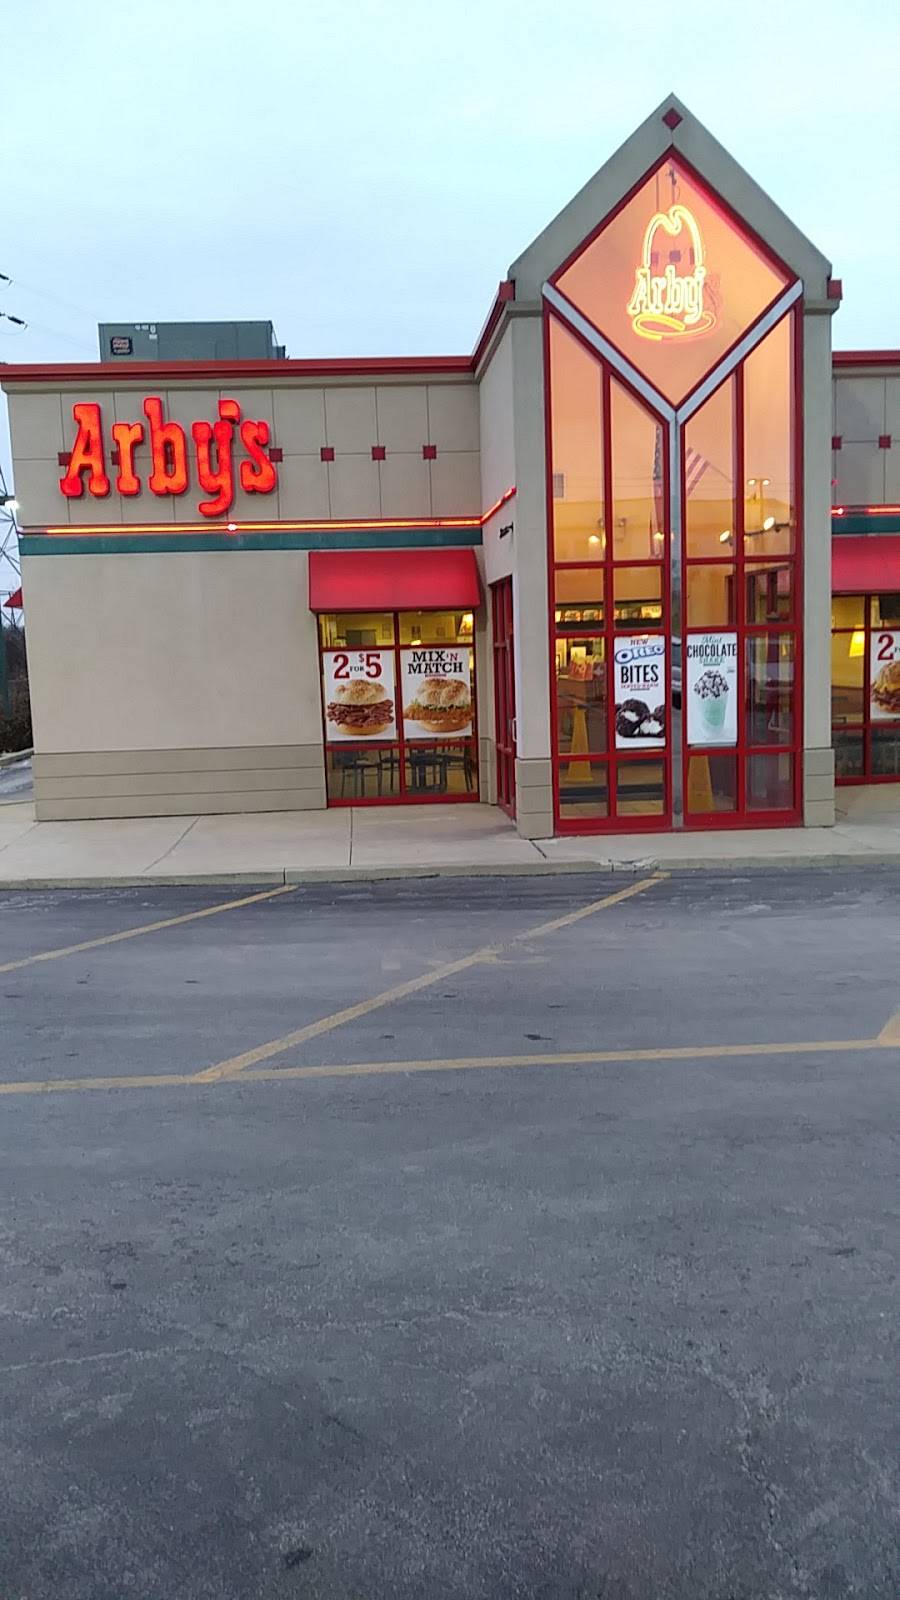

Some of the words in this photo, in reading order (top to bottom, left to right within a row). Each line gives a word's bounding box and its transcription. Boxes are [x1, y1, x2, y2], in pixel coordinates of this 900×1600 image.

[60, 397, 276, 517] Arby's
[630, 638, 648, 646] NEW
[687, 643, 737, 658] CHOCOLATE
[877, 634, 894, 661] 2
[412, 651, 446, 662] MIX
[615, 645, 665, 664] OREO
[333, 654, 350, 679] 2
[408, 662, 463, 674] MATCH
[621, 664, 659, 683] BITES
